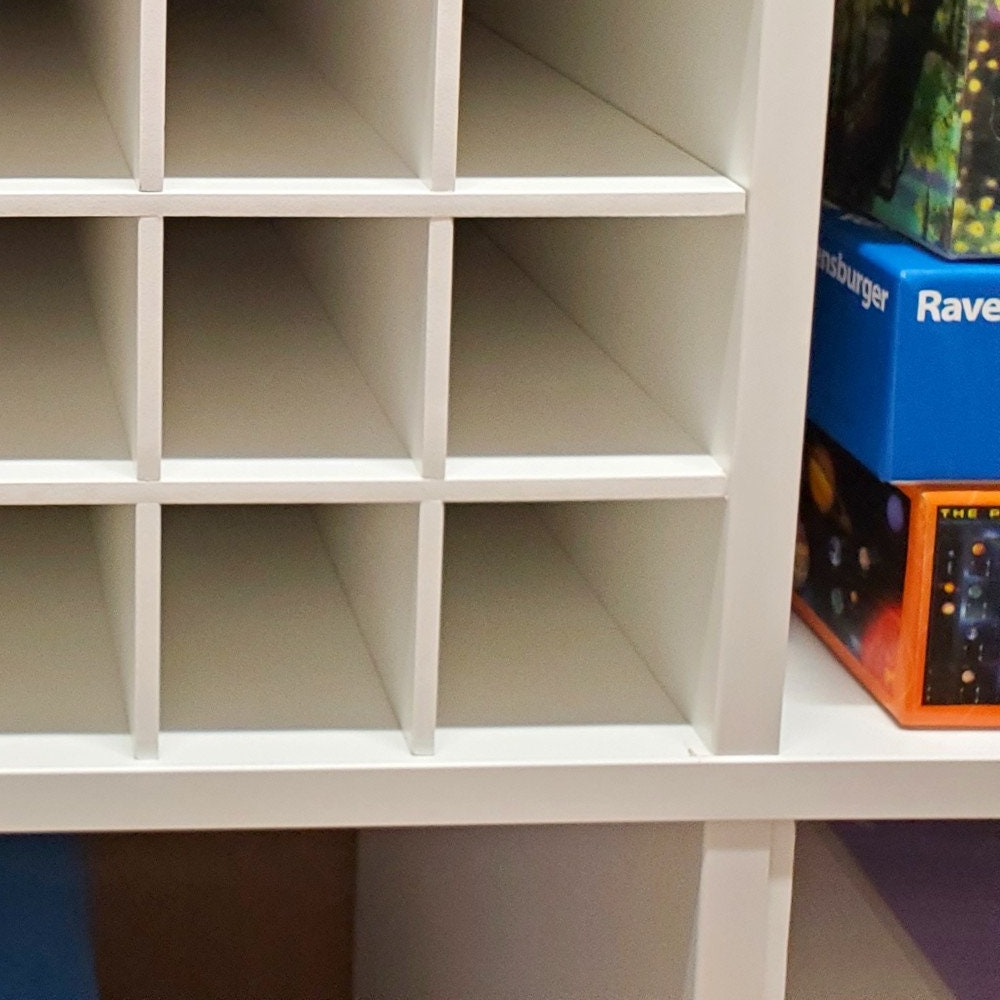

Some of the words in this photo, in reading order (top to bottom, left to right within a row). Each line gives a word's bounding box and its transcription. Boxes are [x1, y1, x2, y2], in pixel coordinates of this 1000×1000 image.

[818, 247, 890, 313] nsburger
[916, 289, 1000, 323] Rave
[940, 508, 977, 519] THE
